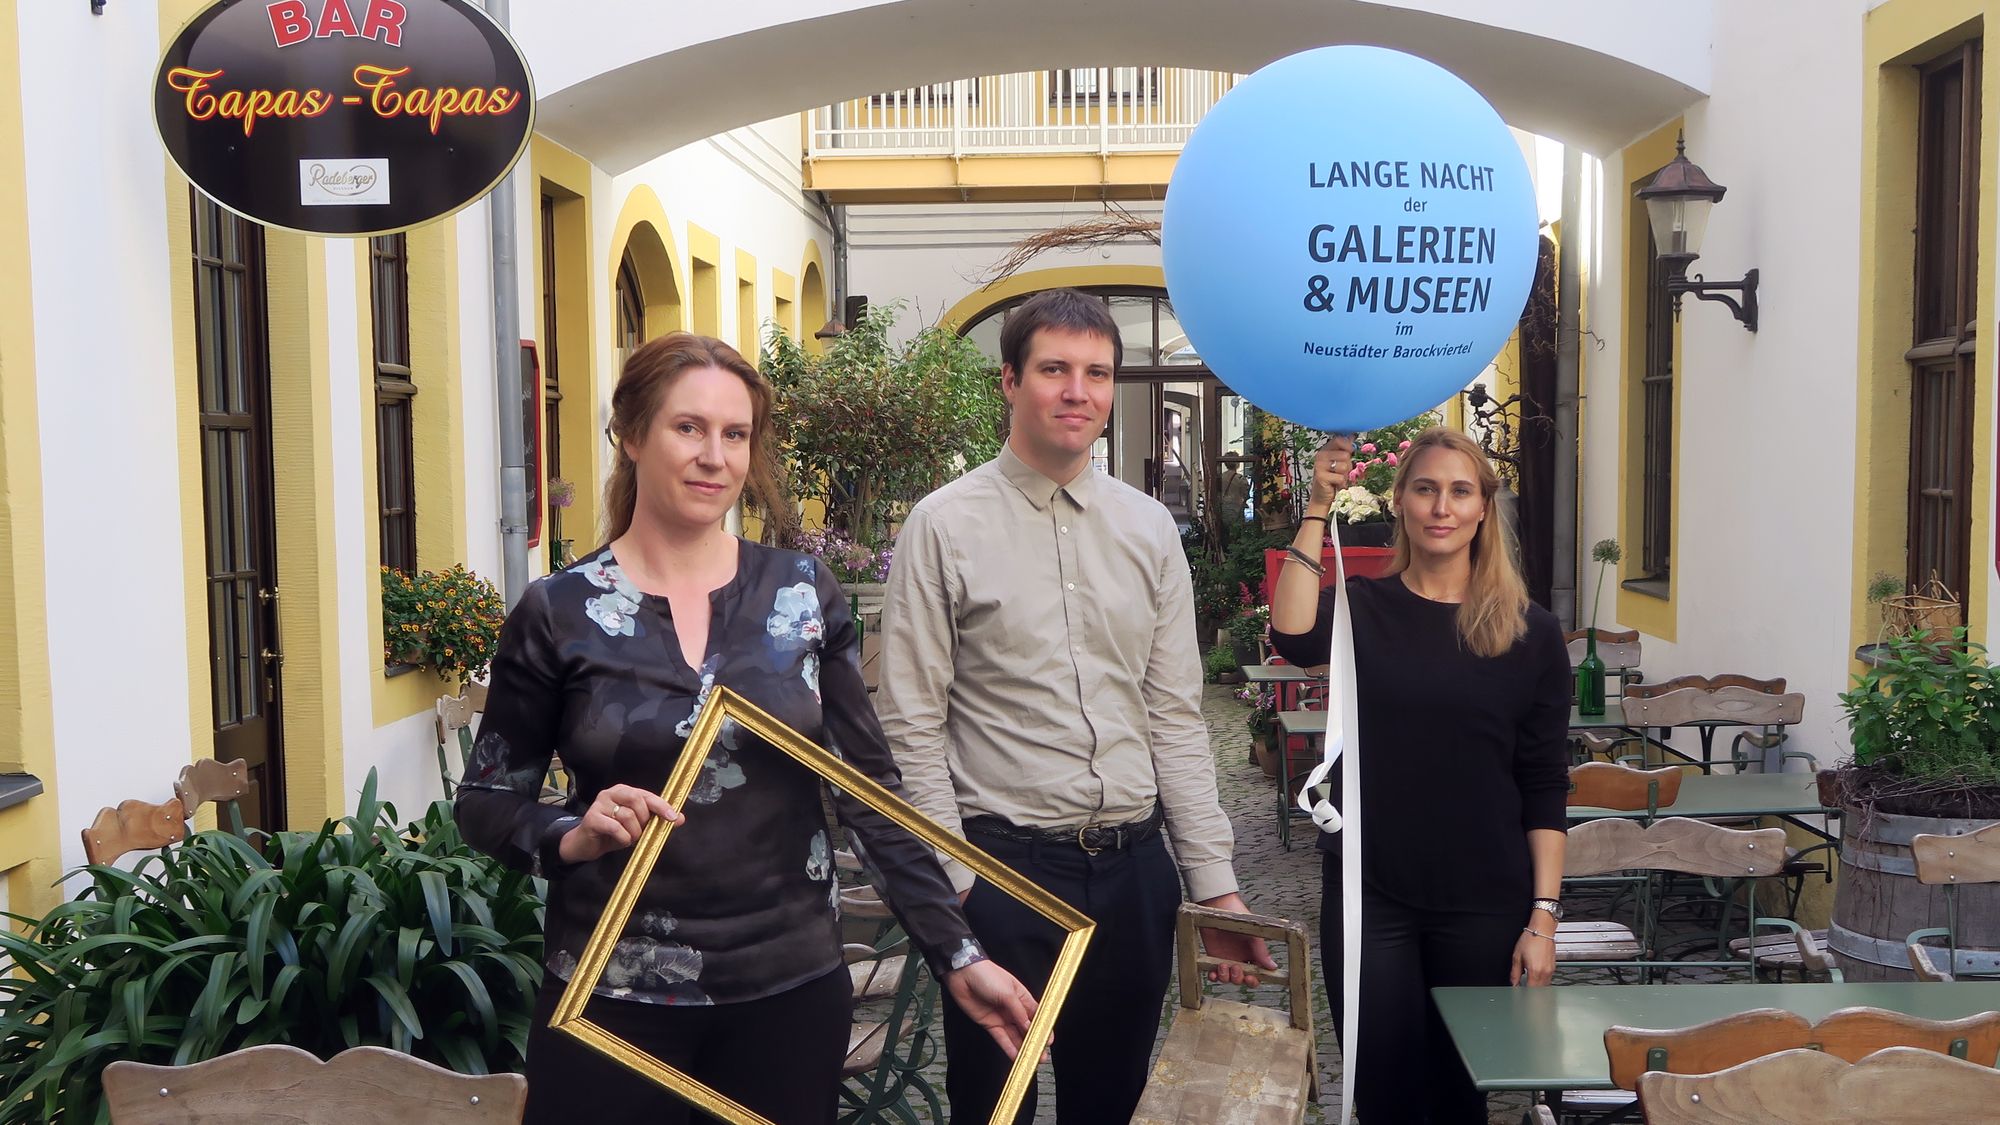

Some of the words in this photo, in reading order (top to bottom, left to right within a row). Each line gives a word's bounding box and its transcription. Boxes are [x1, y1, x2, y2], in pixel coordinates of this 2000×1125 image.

[267, 0, 407, 47] BAR
[167, 65, 334, 137] Tapas
[309, 163, 376, 191] Radeberger
[1309, 160, 1410, 188] LANGE
[1420, 162, 1494, 192] NACHT
[1403, 197, 1427, 212] der
[1308, 224, 1495, 264] GALERIEN
[1303, 275, 1335, 313] &
[1345, 276, 1492, 314] MUSEEN
[1395, 321, 1413, 336] im
[1304, 341, 1389, 358] Neustädter
[1392, 341, 1473, 359] Barockviertel
